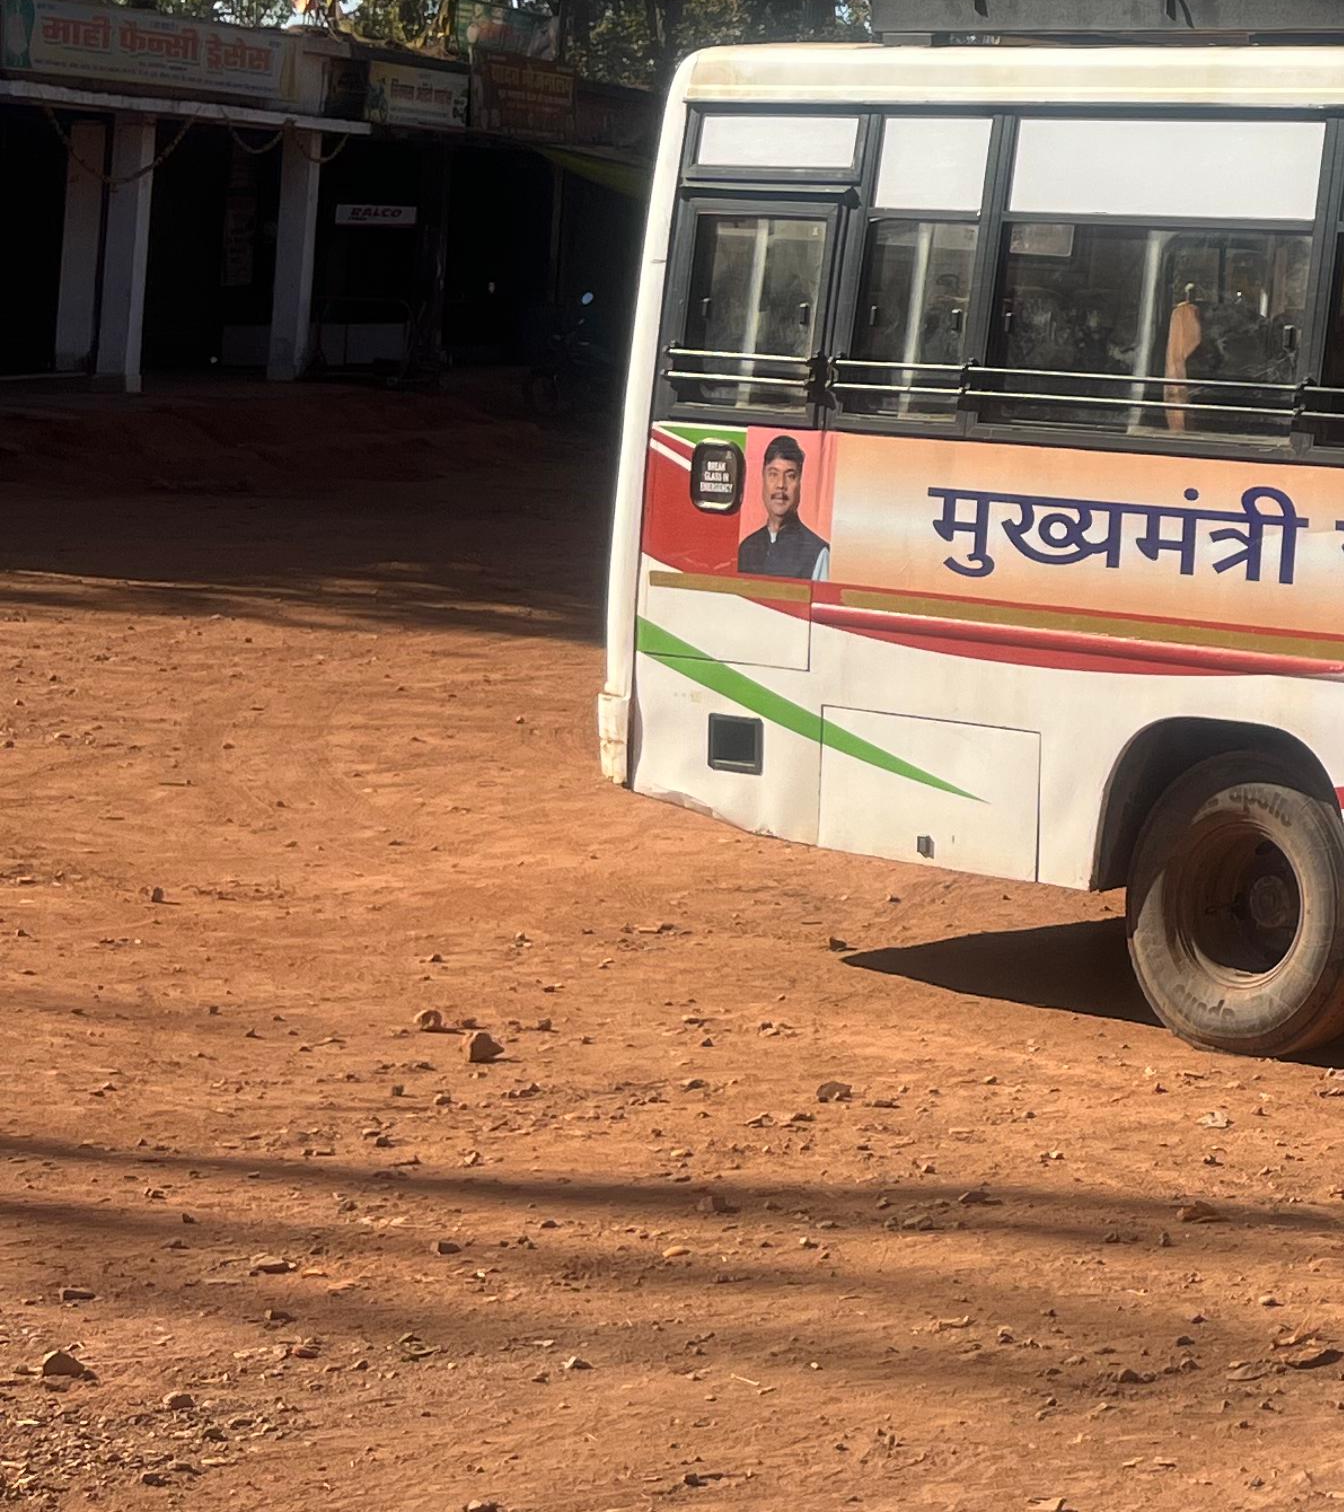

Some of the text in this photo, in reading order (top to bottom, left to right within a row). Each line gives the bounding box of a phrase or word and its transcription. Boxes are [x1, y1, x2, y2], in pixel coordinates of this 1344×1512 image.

[707, 461, 726, 471] BREAK
[704, 471, 730, 482] GLASS IN
[700, 481, 733, 493] EMERGENCY
[928, 486, 1308, 584] मुख्यमंत्री
